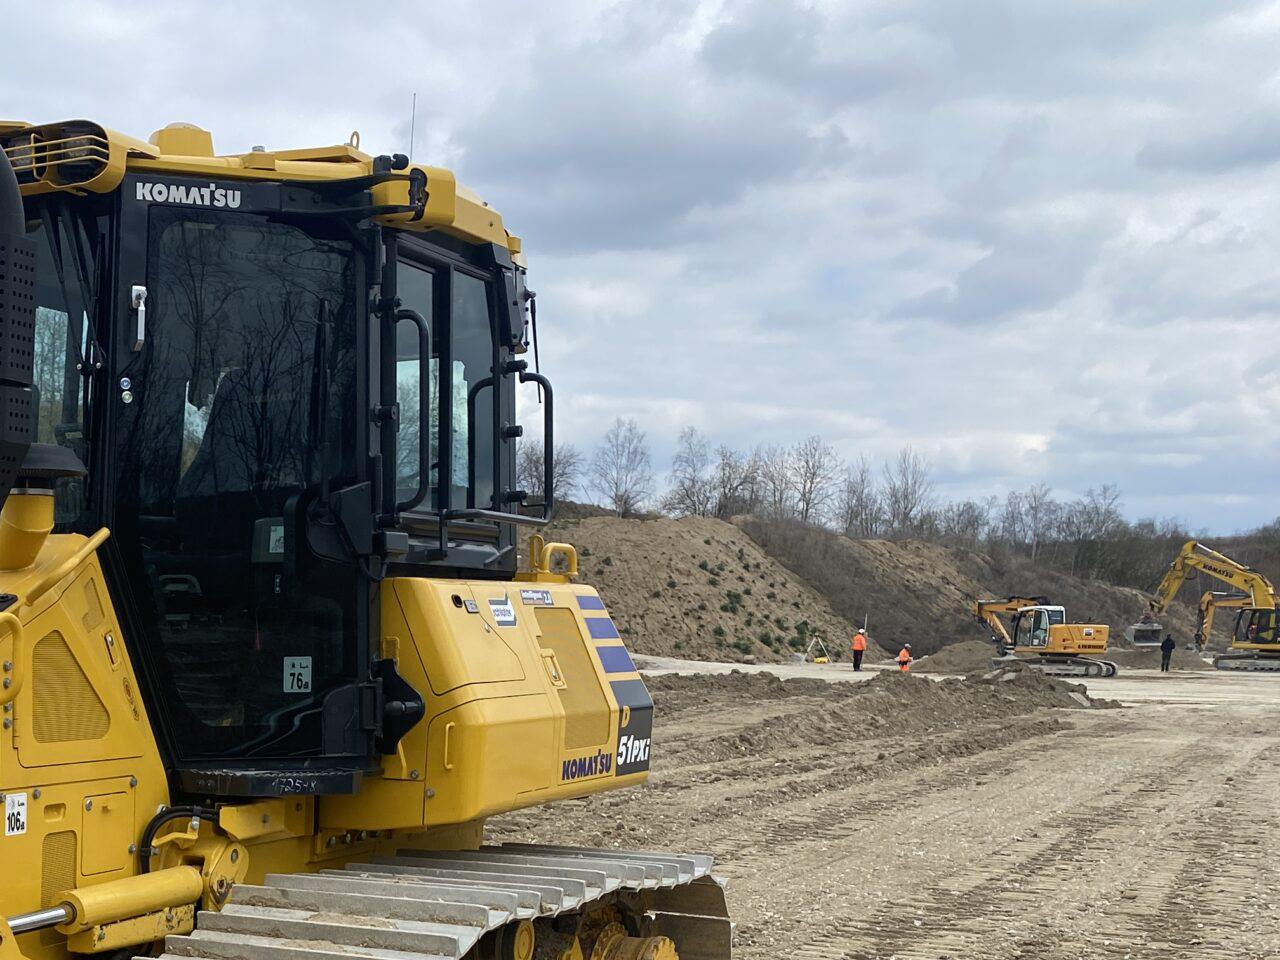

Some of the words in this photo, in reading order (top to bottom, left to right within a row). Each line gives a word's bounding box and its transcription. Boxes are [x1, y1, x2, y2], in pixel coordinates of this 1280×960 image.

[136, 182, 241, 209] KOMATSU
[1203, 563, 1233, 578] KOMATSU
[289, 672, 303, 690] 76
[621, 705, 631, 728] D
[617, 735, 651, 766] 51PXi
[561, 748, 613, 781] KOMATSU
[7, 811, 21, 832] 106
